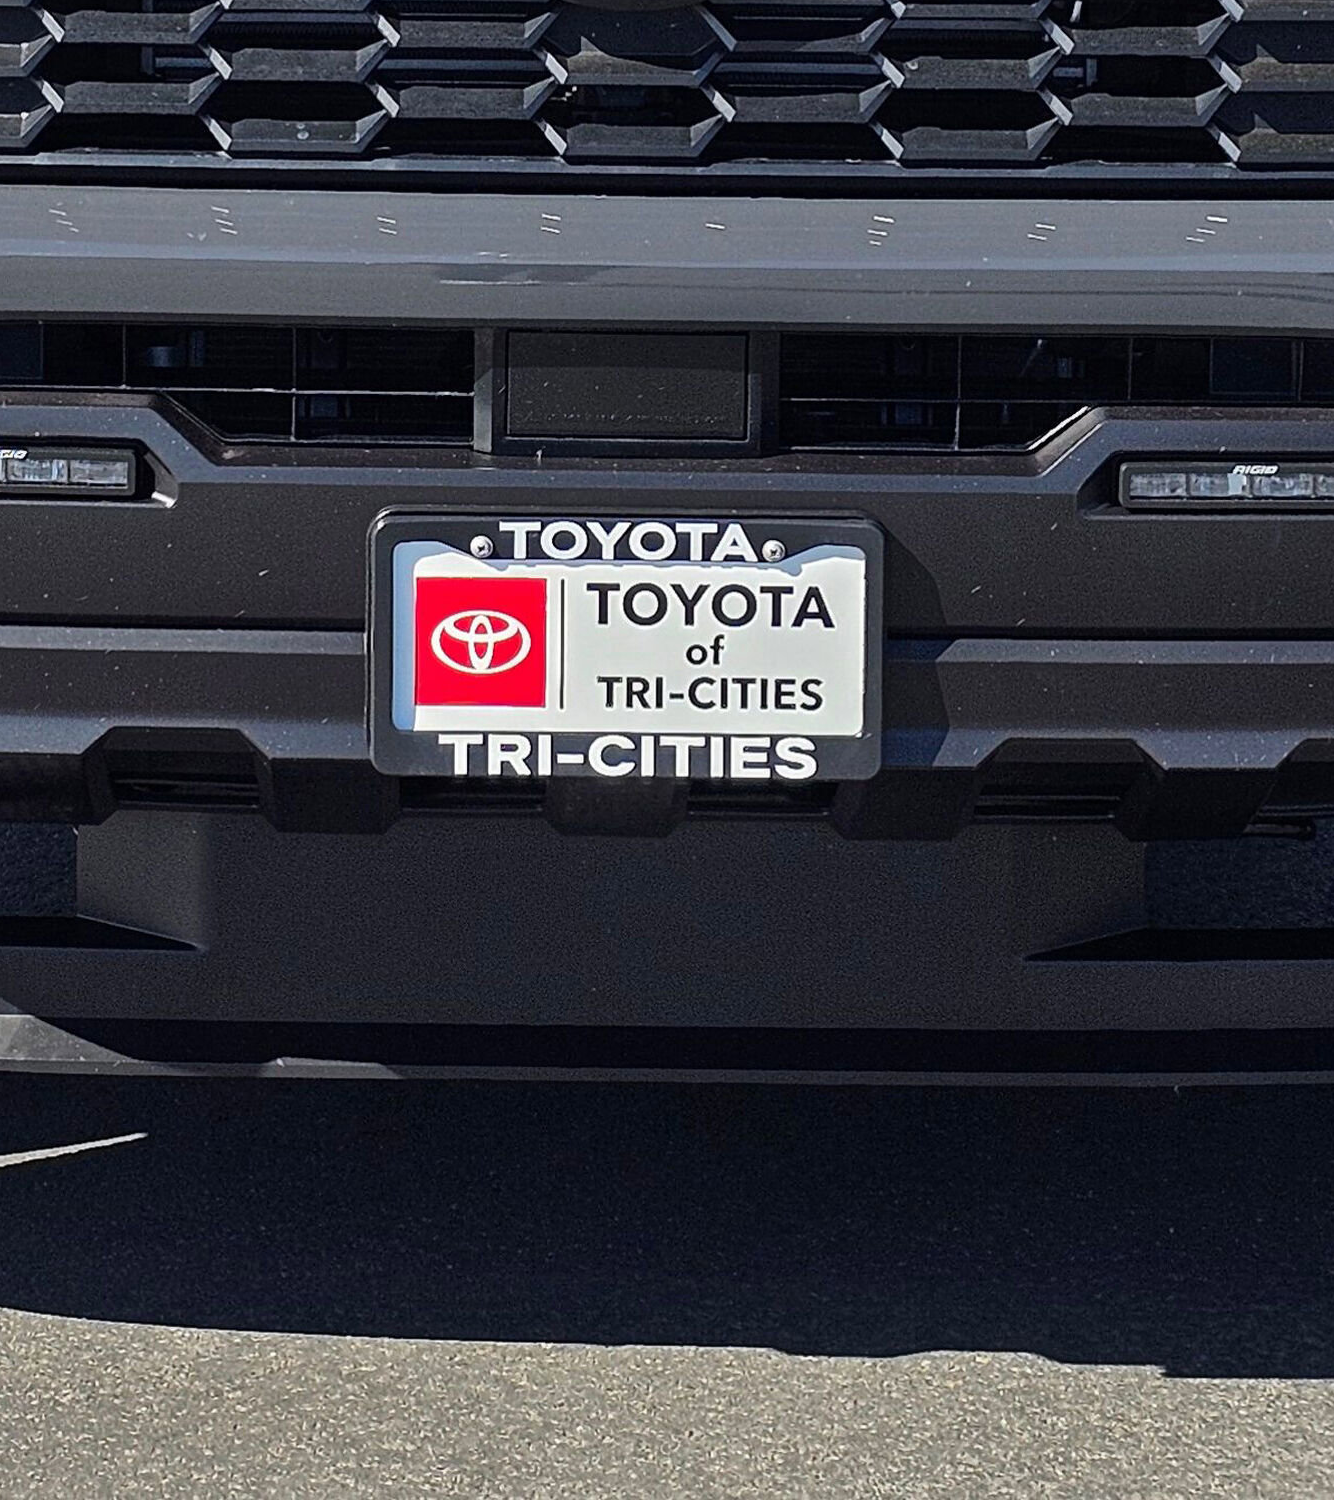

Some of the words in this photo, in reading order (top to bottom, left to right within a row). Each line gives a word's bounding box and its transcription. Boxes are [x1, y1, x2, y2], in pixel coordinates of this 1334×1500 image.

[1232, 464, 1279, 475] RIGID
[498, 520, 758, 562] TOYOTA
[586, 582, 836, 629] TOYOTA
[685, 635, 725, 666] of
[597, 676, 824, 711] TRI-CITIES
[438, 733, 818, 779] TRI-CITIES
